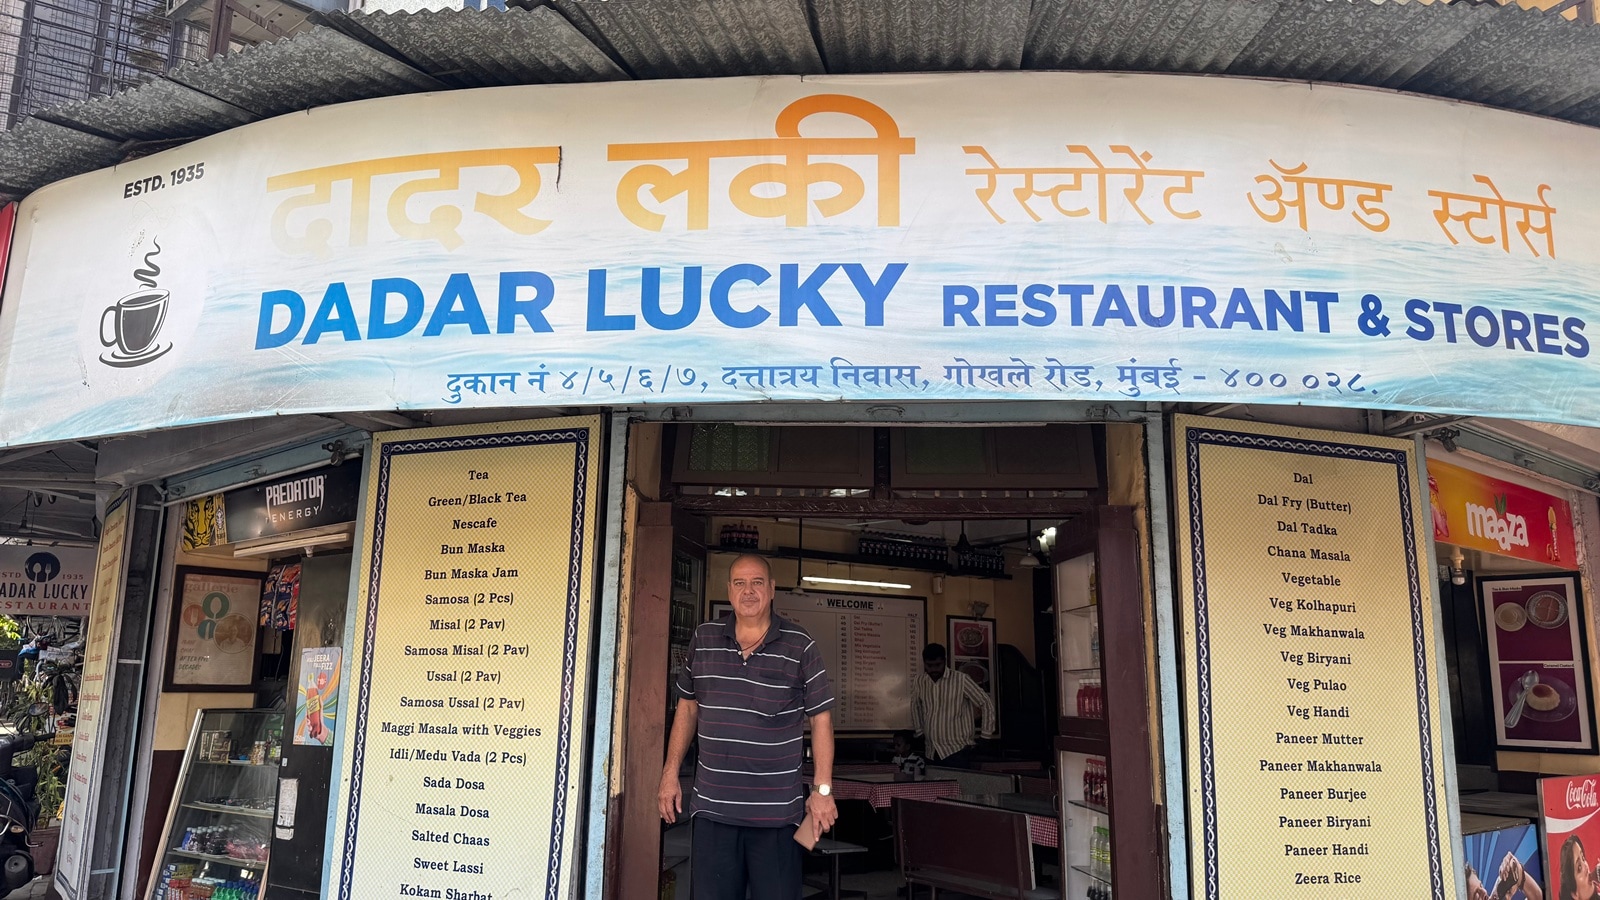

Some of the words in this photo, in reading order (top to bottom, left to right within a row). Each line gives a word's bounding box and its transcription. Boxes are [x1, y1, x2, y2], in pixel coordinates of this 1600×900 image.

[123, 173, 166, 199] ESTD.
[169, 162, 205, 188] 1935
[266, 145, 560, 260] दादर
[607, 93, 916, 232] लकी
[962, 144, 1204, 226] रेस्टोरेंट
[1428, 174, 1557, 259] स्टोर्स
[254, 270, 556, 350] DADAR
[586, 263, 909, 332] LUCKY
[942, 284, 1339, 334] RESTAURANT
[1357, 294, 1392, 337] &
[1405, 299, 1590, 359] STORES
[443, 370, 521, 404] दुकान
[527, 362, 548, 393] नं
[721, 365, 824, 391] दत्तात्रय
[830, 356, 929, 391] निवास,
[943, 357, 1035, 388] गोखले
[1043, 357, 1101, 393] रोड,
[1116, 357, 1182, 396] मुंबई
[1220, 366, 1288, 389] ४००
[468, 470, 489, 480] Tea
[1293, 473, 1313, 484] Dal
[266, 475, 324, 518] PREDATOR
[428, 493, 502, 507] Green/Black
[506, 493, 527, 502] Tea
[1258, 494, 1278, 506] Dal
[1282, 497, 1302, 510] Fry
[1307, 499, 1352, 514] (Butter)
[272, 506, 320, 523] ENERGY
[452, 518, 497, 529] Nescafe
[1277, 521, 1297, 533] Dal
[1301, 522, 1338, 536] Tadka
[1465, 501, 1530, 551] maaza
[441, 545, 463, 554] Bun
[468, 543, 505, 553] Maska
[1267, 546, 1306, 559] Chana
[1310, 549, 1351, 562] Masala
[0, 571, 22, 579] STD
[424, 570, 446, 580] Bun
[451, 569, 488, 579] Maska
[492, 568, 518, 578] Jam
[1282, 572, 1341, 587] Vegetable
[0, 582, 36, 598] ADAR
[43, 583, 88, 599] LUCKY
[0, 600, 91, 611] STAURANT
[425, 595, 469, 604] Samosa
[474, 593, 485, 606] (2
[489, 593, 514, 605] Pcs)
[826, 598, 874, 610] WELCOME
[1269, 598, 1293, 612] Veg
[1297, 599, 1356, 614] Kolhapuri
[430, 620, 461, 630] Misal
[464, 619, 475, 632] (2
[480, 618, 505, 632] Pav)
[1263, 623, 1286, 638] Veg
[1290, 625, 1365, 640] Makhanwala
[313, 654, 330, 662] JEERA
[404, 646, 448, 656] Samosa
[452, 645, 483, 656] Misal
[487, 645, 499, 658] (2
[503, 644, 529, 657] Pav)
[1280, 651, 1303, 665] Veg
[1307, 652, 1351, 667] Biryani
[427, 671, 457, 682] Ussal
[460, 671, 472, 684] (2
[476, 671, 501, 684] Pav)
[1287, 678, 1310, 692] Veg
[1313, 679, 1347, 691] Pulao
[400, 697, 444, 708] Samosa
[449, 698, 479, 708] Ussal
[483, 698, 494, 711] (2
[499, 698, 525, 711] Pav)
[1287, 705, 1310, 719] Veg
[1313, 706, 1349, 718] Handi
[381, 722, 414, 735] Maggi
[418, 723, 458, 735] Masala
[462, 724, 489, 735] with
[494, 724, 541, 739] Veggies
[1276, 733, 1318, 744] Paneer
[1322, 734, 1364, 745] Mutter
[390, 748, 447, 761] Idli/Medu
[451, 751, 481, 763] Vada
[485, 752, 497, 765] (2
[501, 752, 526, 766] Pcs)
[1259, 760, 1303, 771] Paneer
[1307, 760, 1382, 773] Makhanwala
[423, 777, 451, 789] Sada
[456, 778, 485, 790] Dosa
[1280, 788, 1323, 799] Paneer
[1327, 788, 1367, 802] Burjee
[1566, 779, 1597, 810] Coca-Cola
[415, 803, 456, 816] Masala
[460, 806, 489, 818] Dosa
[1279, 816, 1322, 827] Paneer
[1326, 816, 1371, 830] Biryani
[412, 830, 449, 843] Salted
[454, 833, 490, 846] Chaas
[1284, 844, 1328, 856] Paneer
[1332, 844, 1369, 855] Handi
[414, 858, 449, 871] Sweet
[453, 861, 483, 874] Lassi
[1295, 873, 1329, 885] Zeera
[1334, 872, 1361, 884] Rice
[400, 884, 441, 899] Kokam
[446, 888, 493, 900] Sharbat
